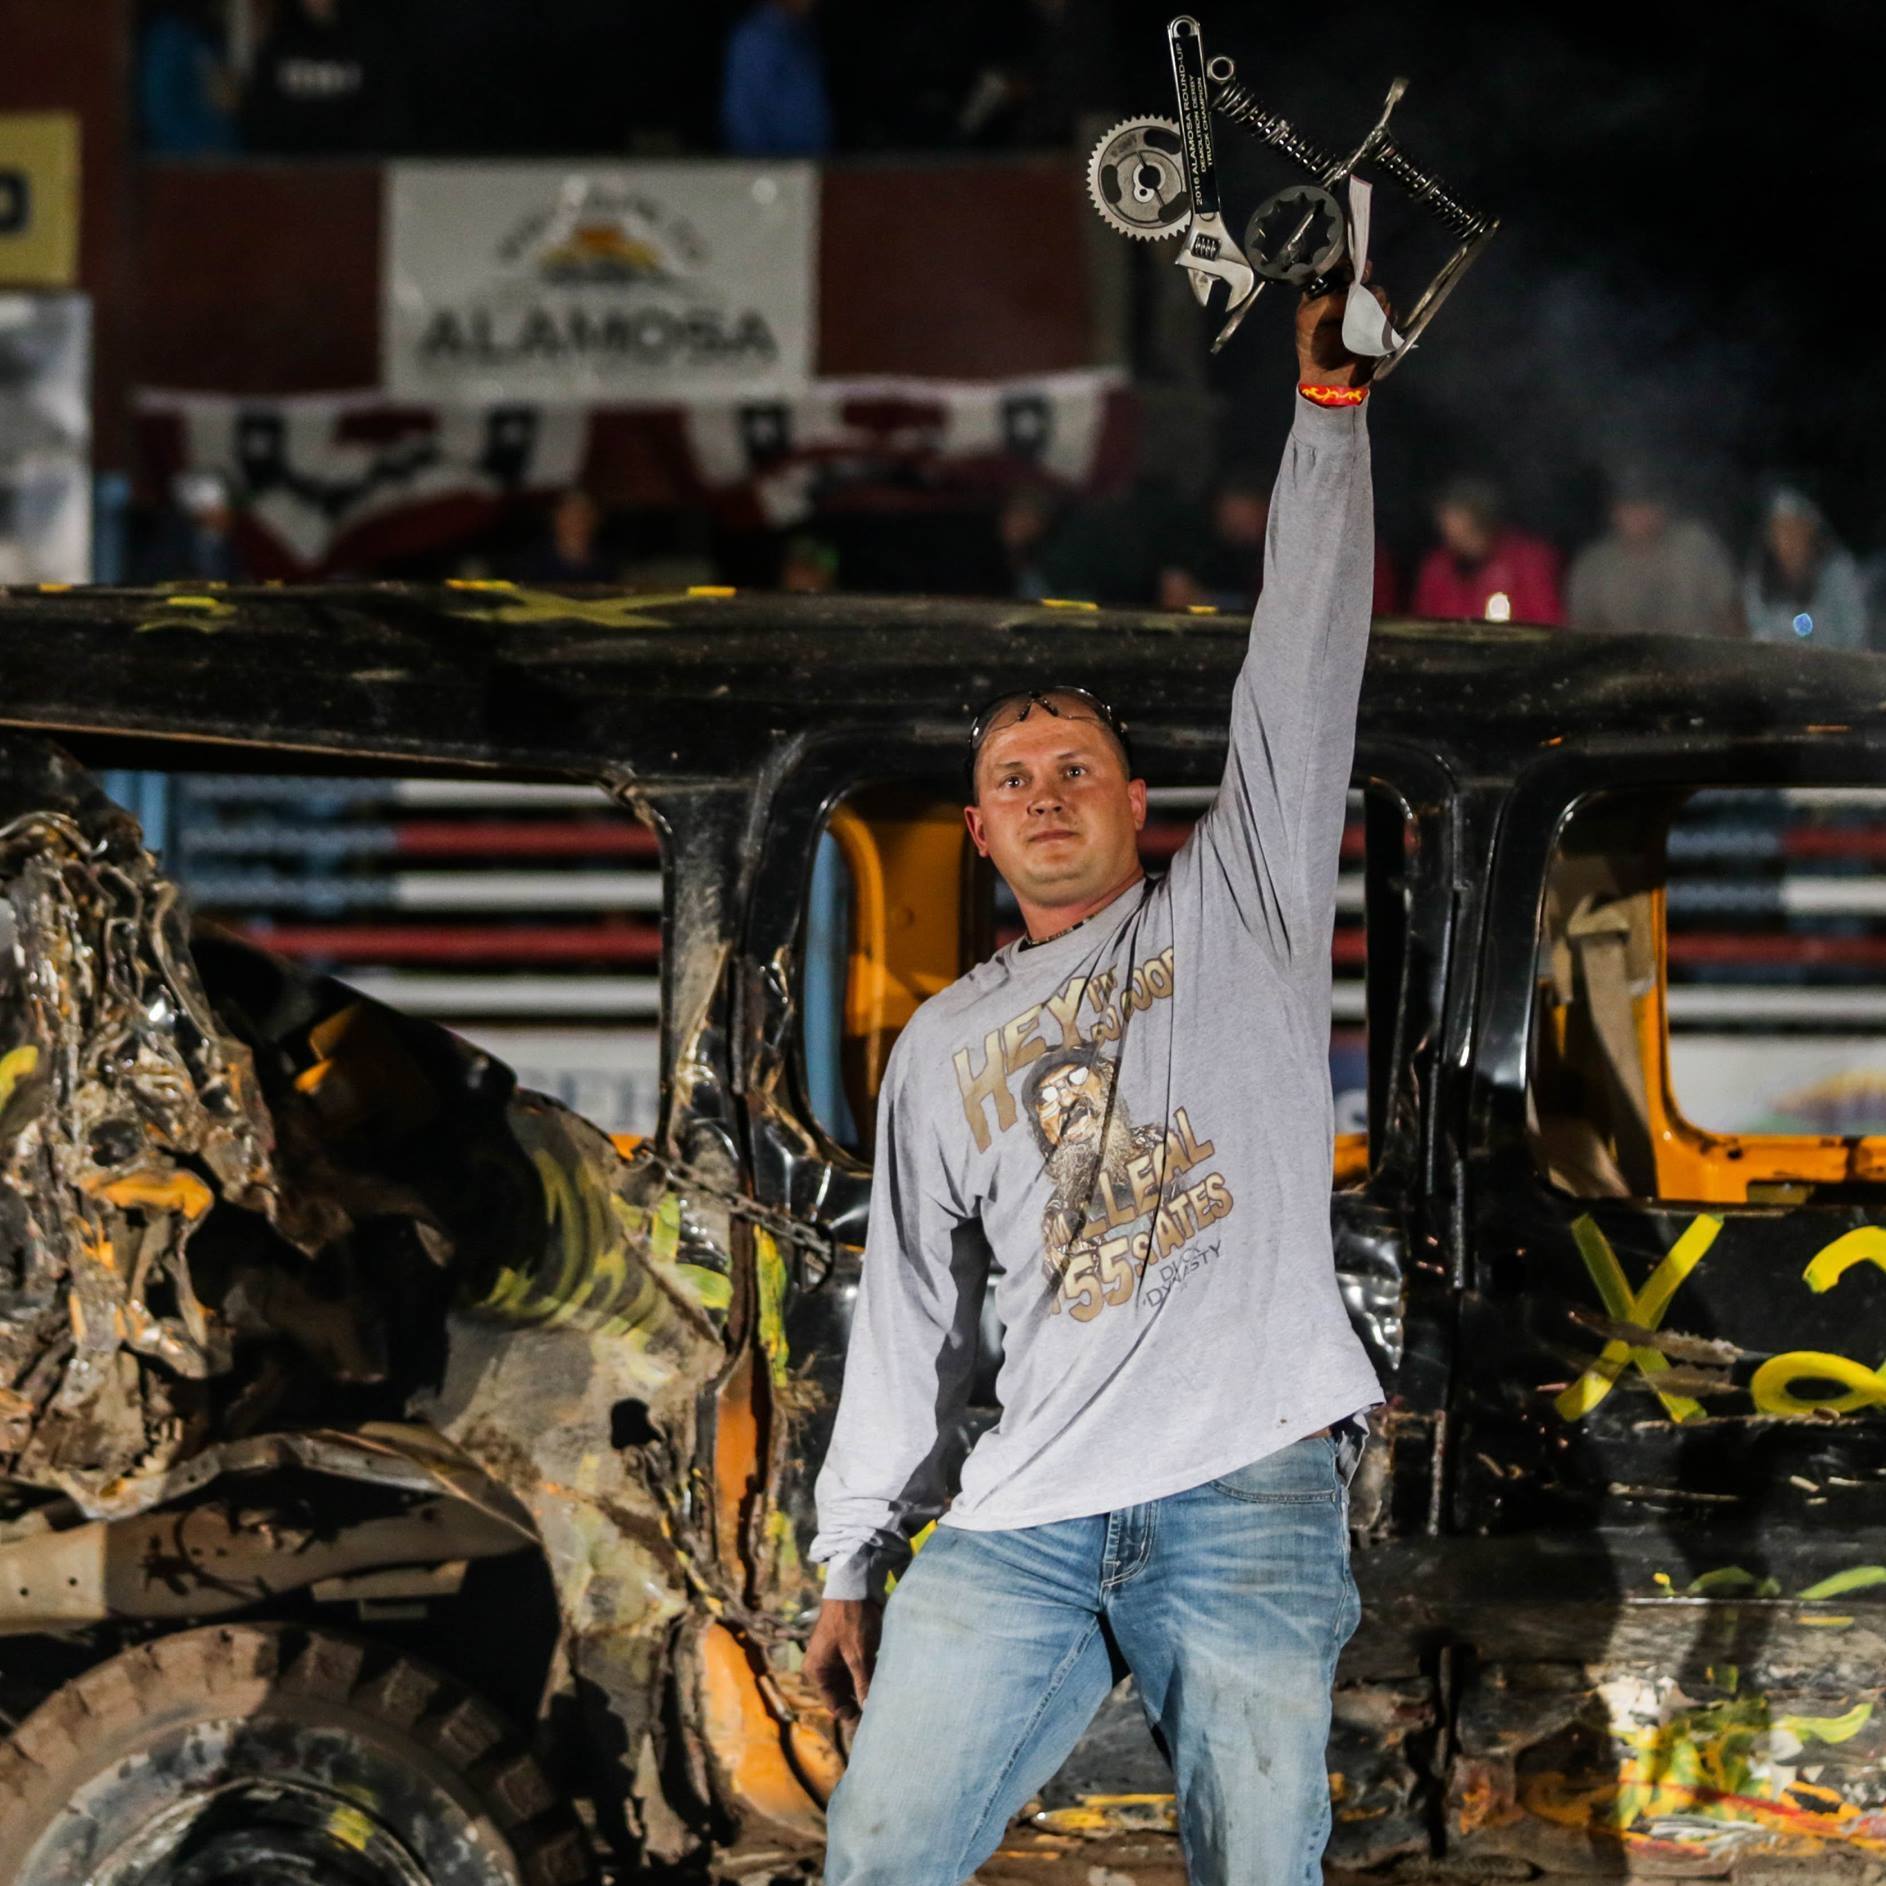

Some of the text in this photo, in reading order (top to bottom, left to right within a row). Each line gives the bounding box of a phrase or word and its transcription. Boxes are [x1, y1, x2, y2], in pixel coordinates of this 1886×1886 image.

[1175, 42, 1190, 111] ROUND-UP
[1185, 113, 1199, 175] ALAMOSA
[1188, 74, 1207, 173] DEMOLITION DERBY
[1196, 77, 1213, 166] TRUCK CHAMPION
[415, 303, 780, 363] ALAMOSA
